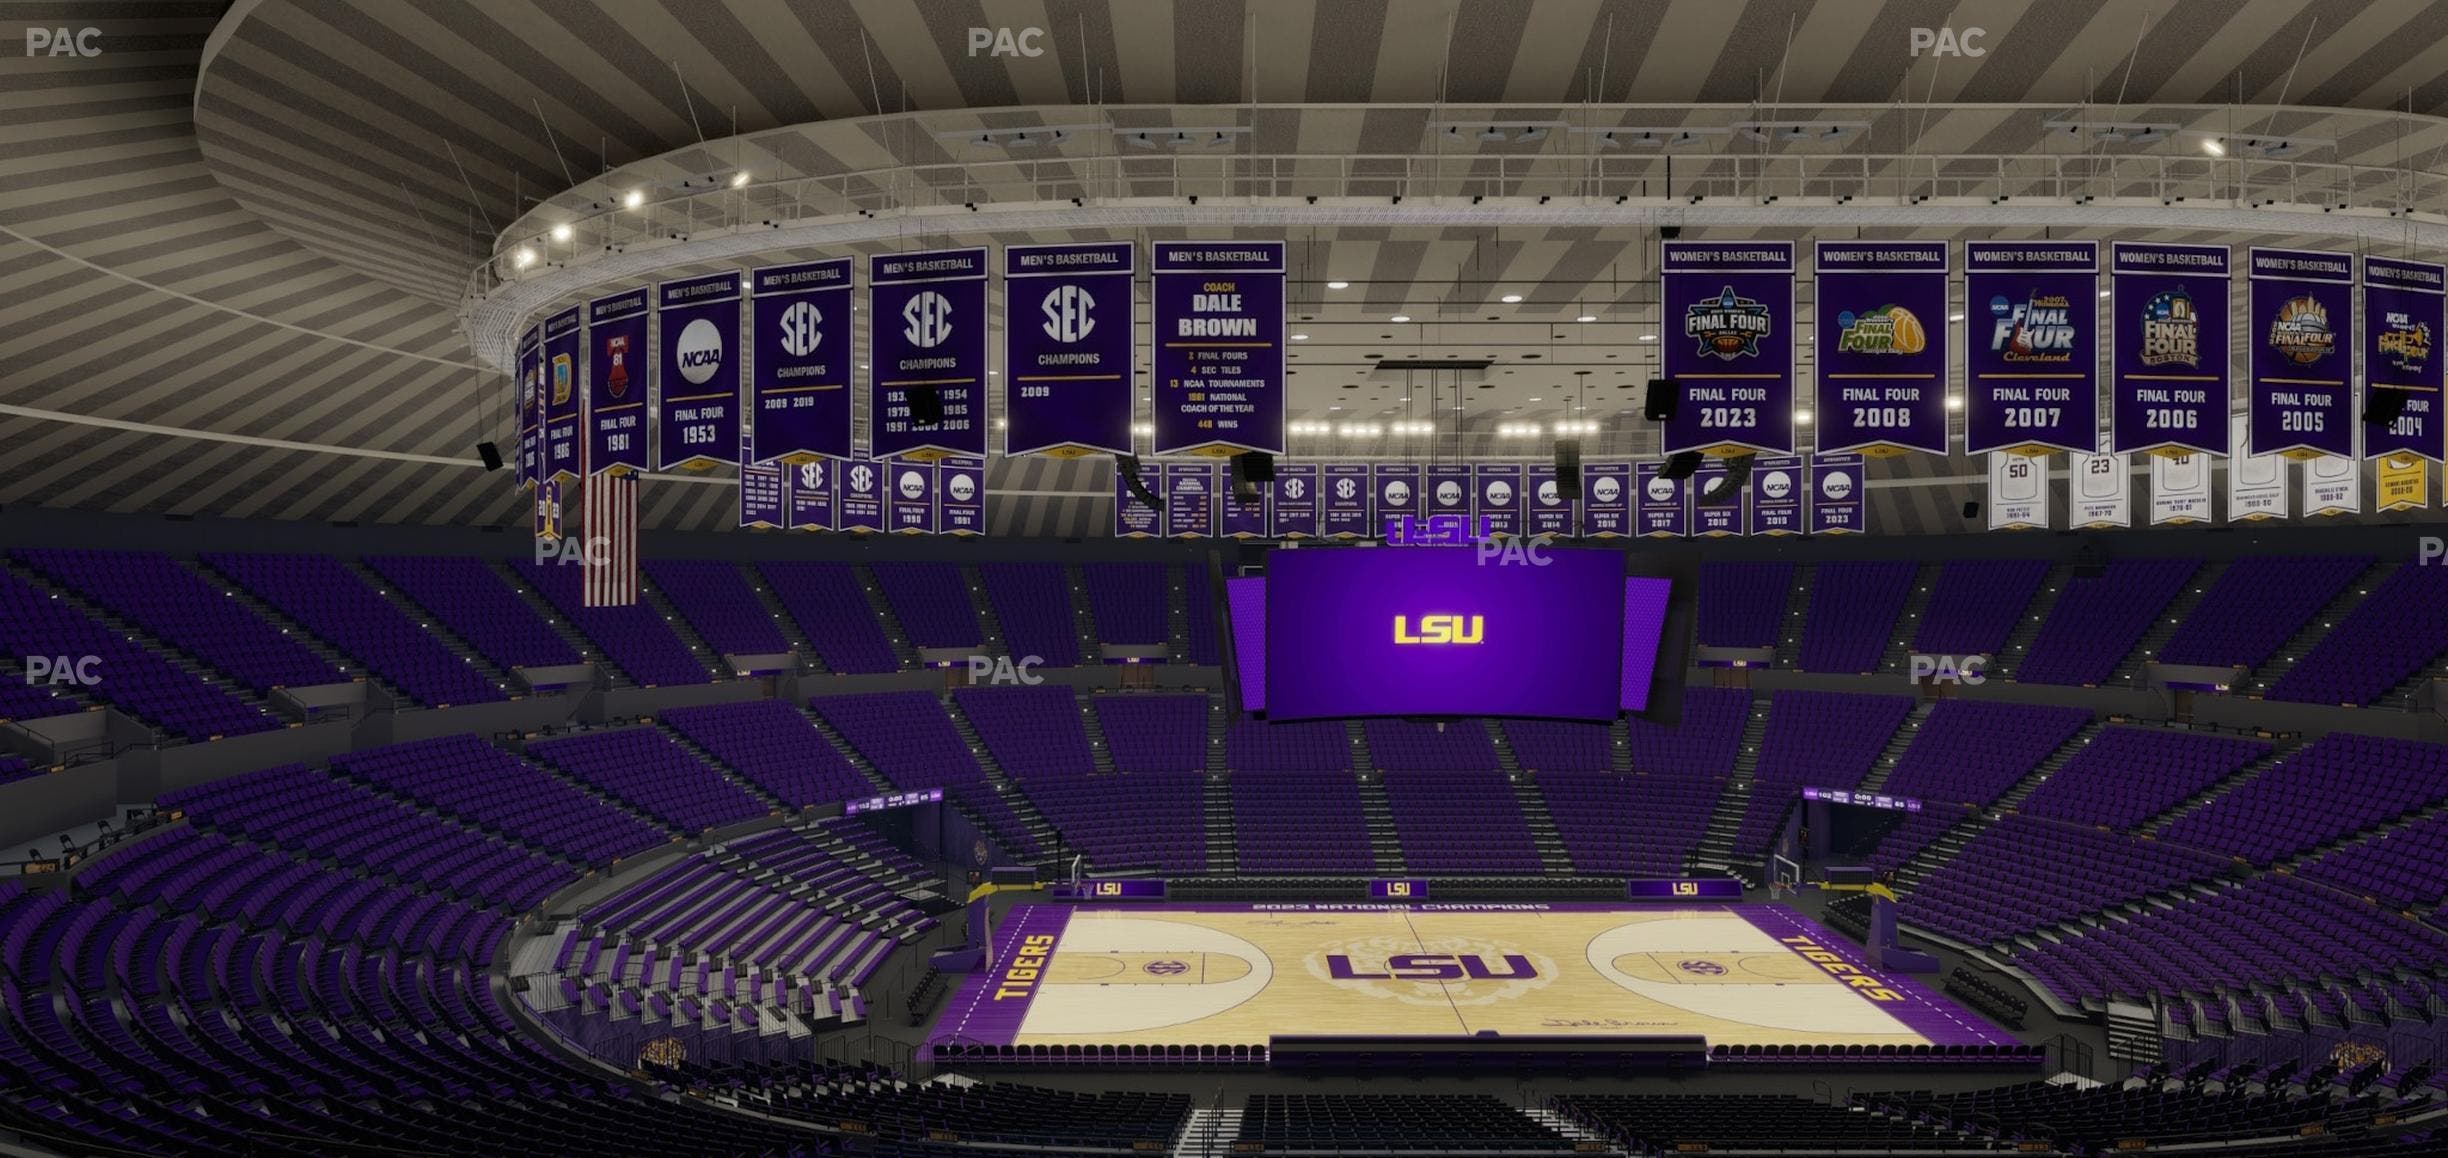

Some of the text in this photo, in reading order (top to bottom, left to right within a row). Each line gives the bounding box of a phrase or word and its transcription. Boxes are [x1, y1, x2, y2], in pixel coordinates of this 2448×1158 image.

[1021, 252, 1119, 266] MEN'S BASKETBALL
[1169, 252, 1270, 262] MEN'S BASKETBALL
[1670, 251, 1786, 261] WOMEN'S BASKETBALL
[1824, 251, 1940, 261] WOMEN'S BASKETBALL
[1973, 251, 2090, 261] WOMEN'S BASKETBALL
[2119, 252, 2224, 266] WOMEN'S BASKETBALL
[883, 258, 973, 274] MEN'S BASKETBALL
[2256, 257, 2348, 273] WOMEN'S BASKETBALL
[763, 268, 841, 286] MEN'S BASKETBALL
[1203, 283, 1235, 292] COACH
[1193, 294, 1241, 312] DALE
[902, 291, 953, 348] SEC
[1041, 285, 1096, 343] SEC
[779, 301, 823, 357] SEC
[1178, 318, 1256, 336] BROWN
[1688, 314, 1766, 332] FINAL FOUR
[1855, 320, 1892, 334] FINAL
[2277, 321, 2301, 331] NCAA
[2145, 321, 2197, 340] FINAL
[1839, 330, 1893, 351] FOUR
[2275, 332, 2332, 345] FINAL FOUR
[2145, 339, 2196, 356] FOUR
[613, 353, 622, 366] 81
[682, 349, 720, 368] NCAA
[1038, 354, 1100, 365] CHAMPIONS
[1198, 352, 1219, 360] FINAL
[1222, 352, 1248, 360] FOURS
[2003, 351, 2071, 362] Cleveland
[2150, 355, 2190, 363] BOSTON
[899, 357, 956, 370] CHAMPIONS
[1191, 366, 1197, 374] 4
[1202, 366, 1217, 374] SEC
[777, 365, 826, 378] CHAMPIONS
[1170, 379, 1265, 388] 13 NCAA TOURNAMENTS
[944, 389, 967, 399] 1954
[1021, 387, 1049, 397] 2009
[1210, 393, 1247, 401] NATIONAL
[1689, 388, 1766, 401] FINAL FOUR
[1843, 388, 1920, 401] FINAL FOUR
[1993, 388, 2070, 401] FINAL FOUR
[2137, 390, 2206, 403] FINAL FOUR
[793, 397, 814, 407] 2019
[2271, 392, 2332, 407] FINAL FOUR
[2407, 400, 2429, 412] FOUR
[675, 406, 724, 421] FINAL FOUR
[887, 405, 968, 417] 1979 1985
[1181, 404, 1255, 413] COACH OF THE YEAR
[600, 415, 636, 430] FINAL FOUR
[1218, 420, 1238, 428] WINS
[1700, 408, 1756, 427] 2023
[1853, 408, 1911, 427] 2008
[2004, 408, 2061, 427] 2007
[2147, 409, 2197, 428] 2006
[2282, 411, 2324, 432] 2005
[886, 420, 969, 432] 1991 2006
[683, 425, 716, 444] 1953
[607, 434, 629, 451] 1981
[2010, 464, 2028, 478] 50
[2091, 459, 2110, 474] 23
[801, 462, 823, 489] SEC
[850, 465, 873, 492] SEC
[903, 484, 923, 492] NCAA
[1285, 478, 1304, 499] SEC
[1336, 478, 1356, 499] SEC
[1766, 483, 1790, 491] NCAA
[1652, 519, 1671, 527] 2017
[1825, 515, 1848, 523] 2023
[1394, 615, 1484, 644] LSU
[1096, 882, 1122, 896] LSU
[1387, 882, 1411, 896] LSU
[1672, 882, 1698, 896] LSU
[994, 935, 1055, 1001] TIGERS
[1326, 955, 1539, 980] LSU
[1781, 936, 1905, 1001] TIGERS
